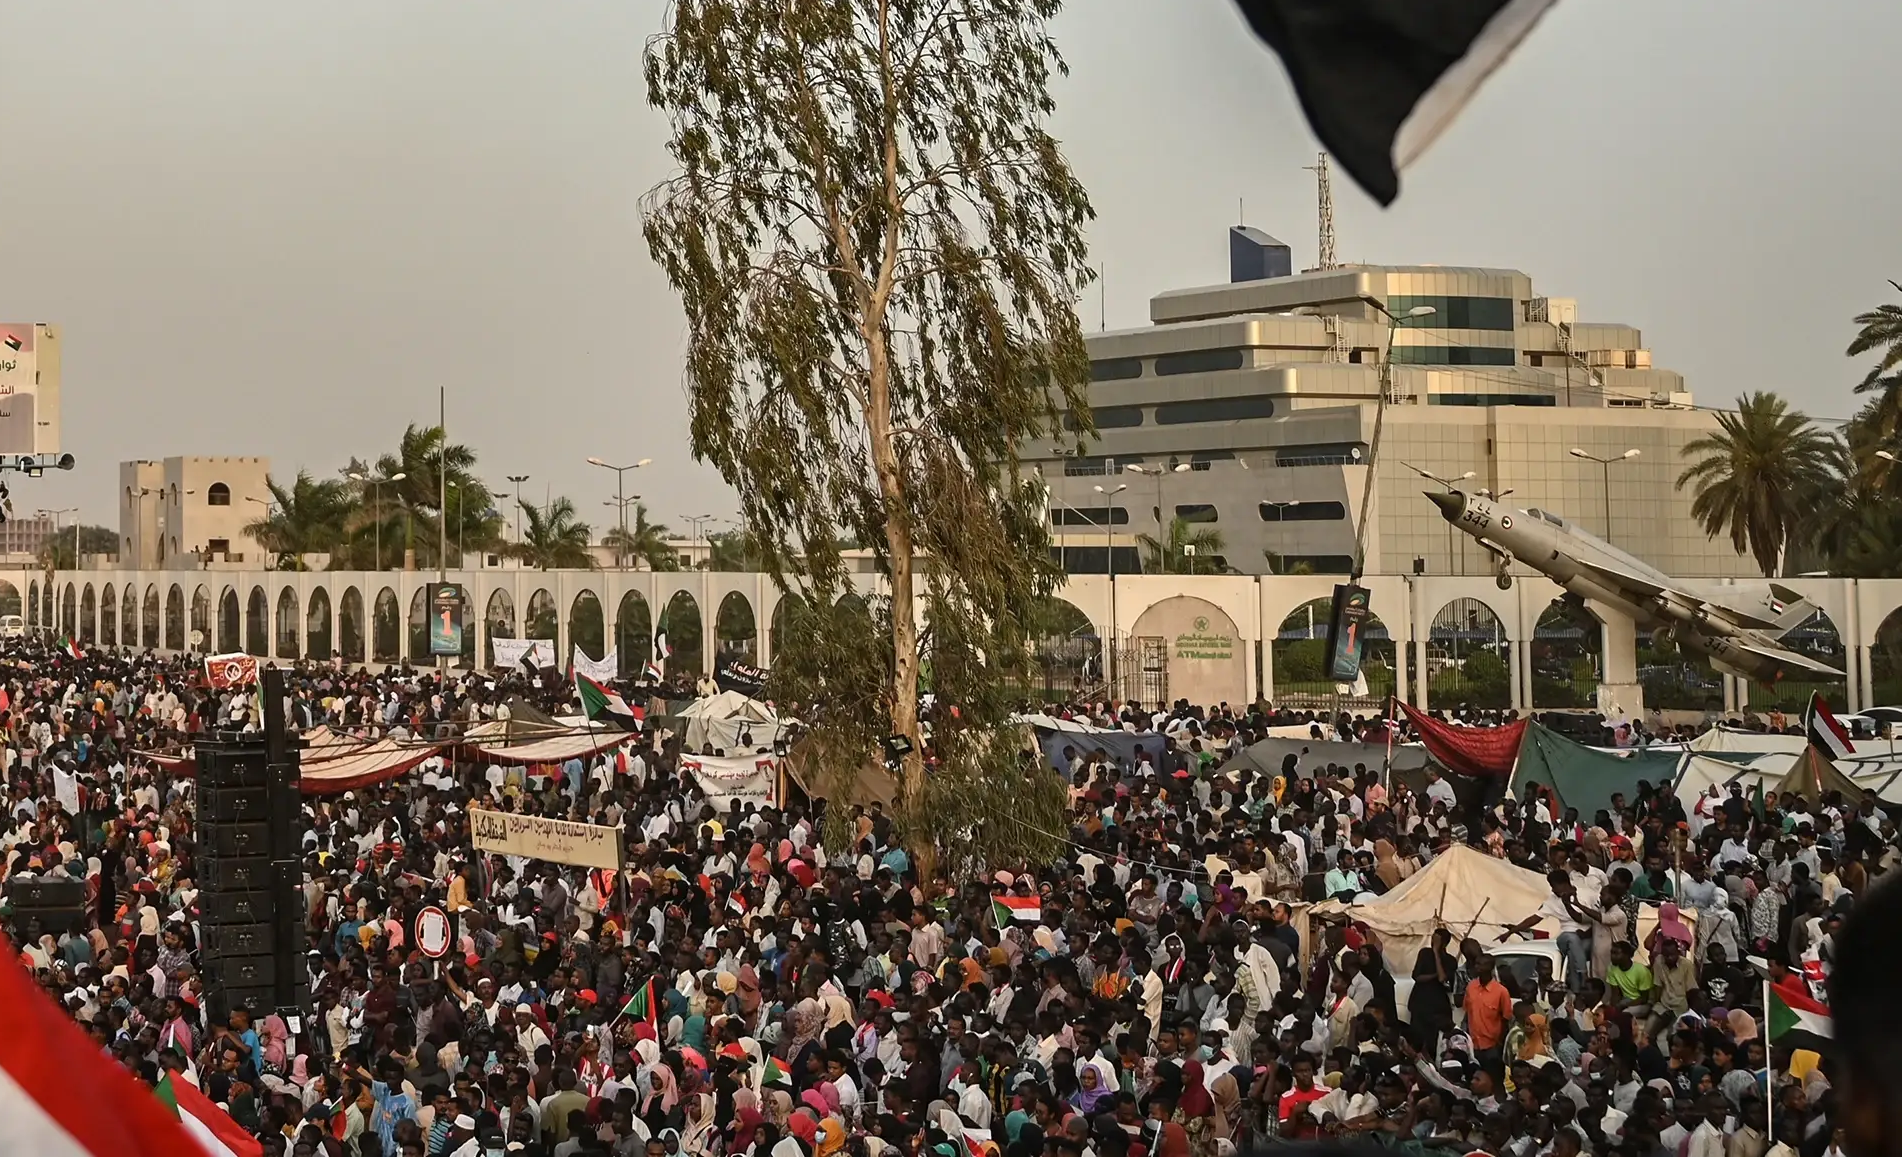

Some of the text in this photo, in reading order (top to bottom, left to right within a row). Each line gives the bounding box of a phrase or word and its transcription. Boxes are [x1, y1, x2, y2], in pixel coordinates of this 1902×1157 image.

[1463, 509, 1490, 529] 344
[440, 610, 453, 636] 1
[1345, 622, 1357, 655] 1
[1704, 637, 1728, 654] 344
[1177, 650, 1199, 659] ATM
